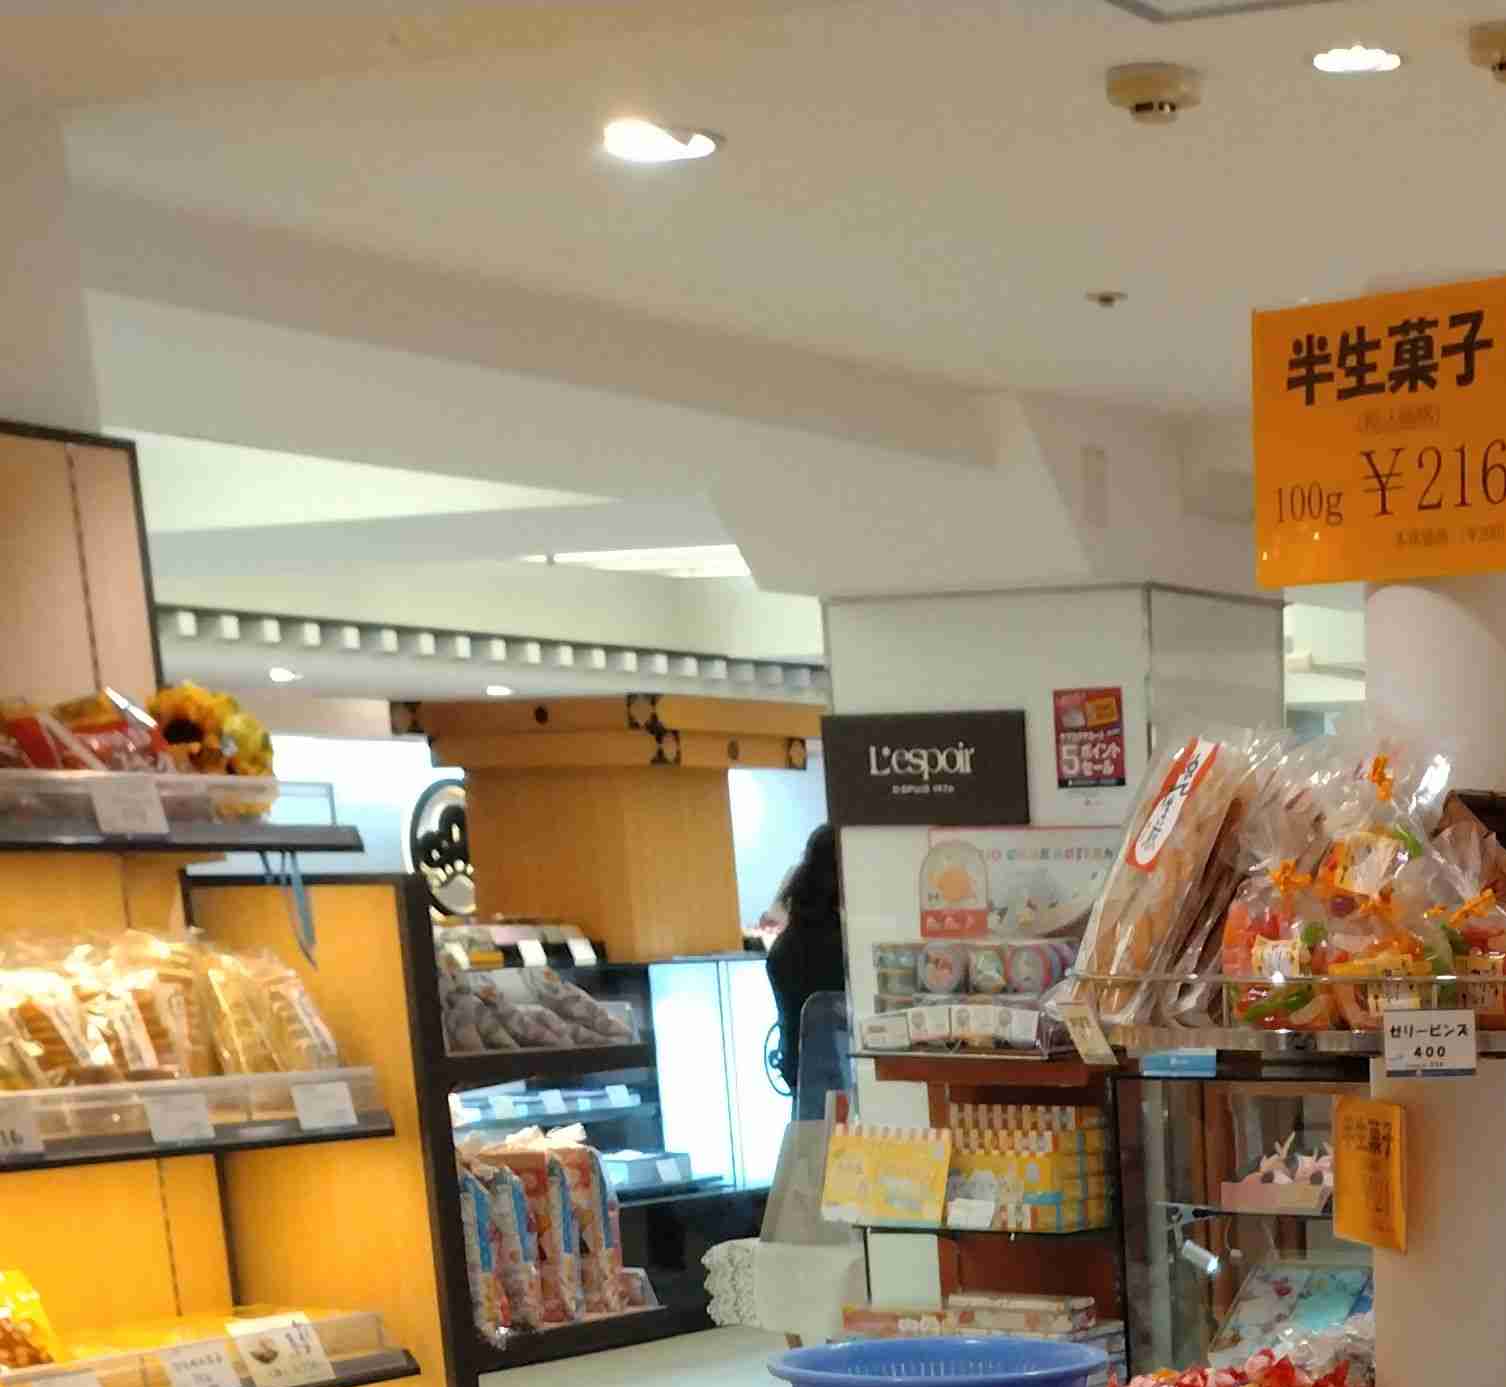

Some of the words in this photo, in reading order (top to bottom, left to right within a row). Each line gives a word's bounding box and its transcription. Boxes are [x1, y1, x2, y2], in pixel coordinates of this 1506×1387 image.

[1286, 310, 1494, 406] 半生菓子
[1273, 480, 1345, 527] 100g
[869, 741, 975, 781] L'espoir
[1414, 1046, 1446, 1058] 400
